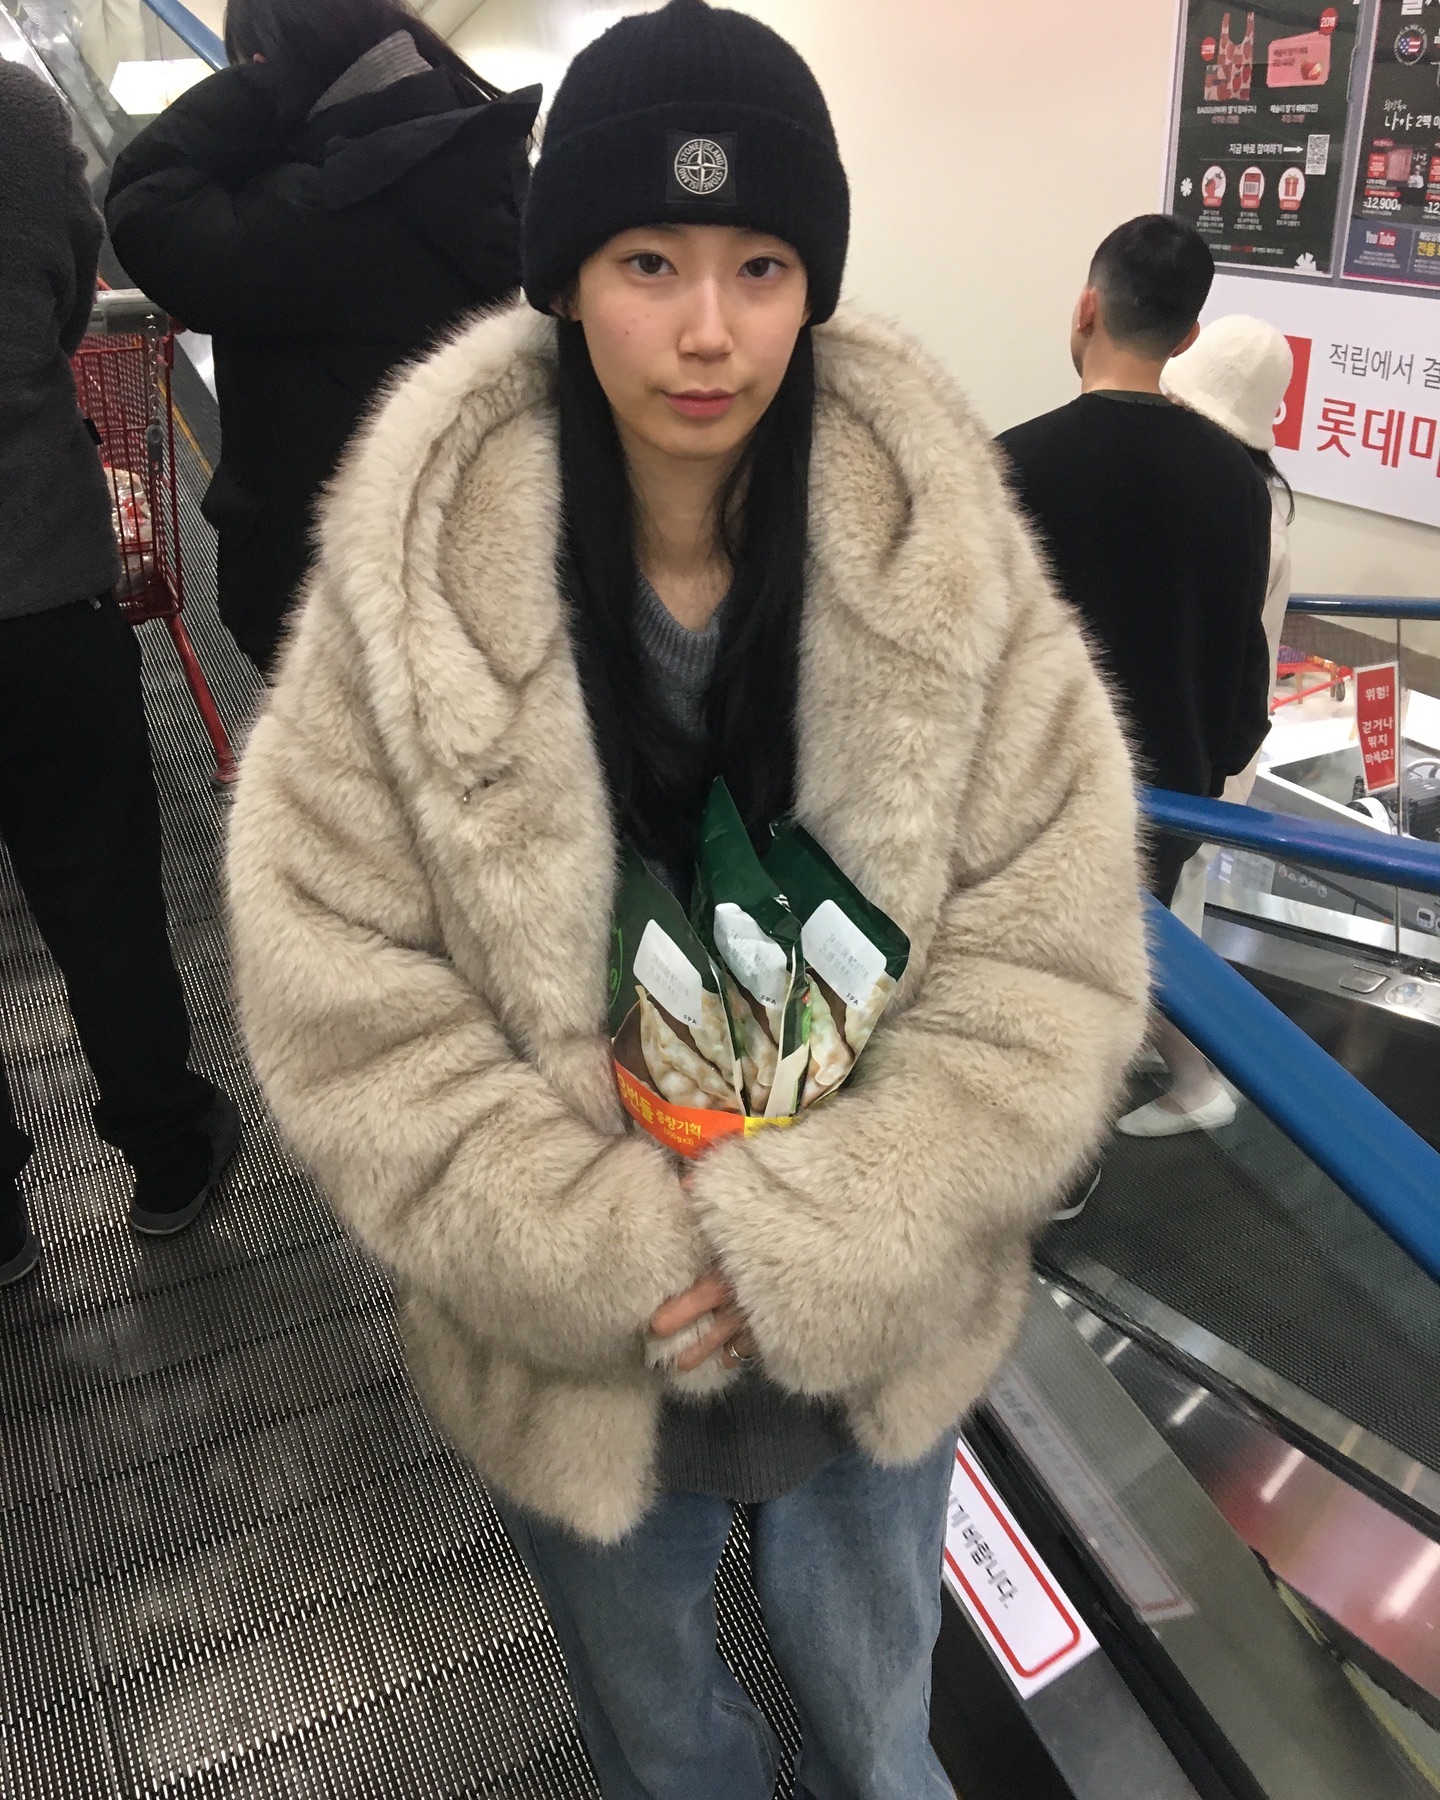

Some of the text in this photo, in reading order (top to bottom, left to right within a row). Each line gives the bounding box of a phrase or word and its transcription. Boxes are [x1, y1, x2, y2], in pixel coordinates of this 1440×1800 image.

[680, 141, 724, 166] STONE ISLAND
[1329, 343, 1414, 385] 적립에서
[1365, 685, 1390, 701] 위험!
[1361, 716, 1394, 734] 걷거나
[1364, 748, 1394, 766] 마세요!
[961, 1523, 1019, 1610] 바랍니다.
